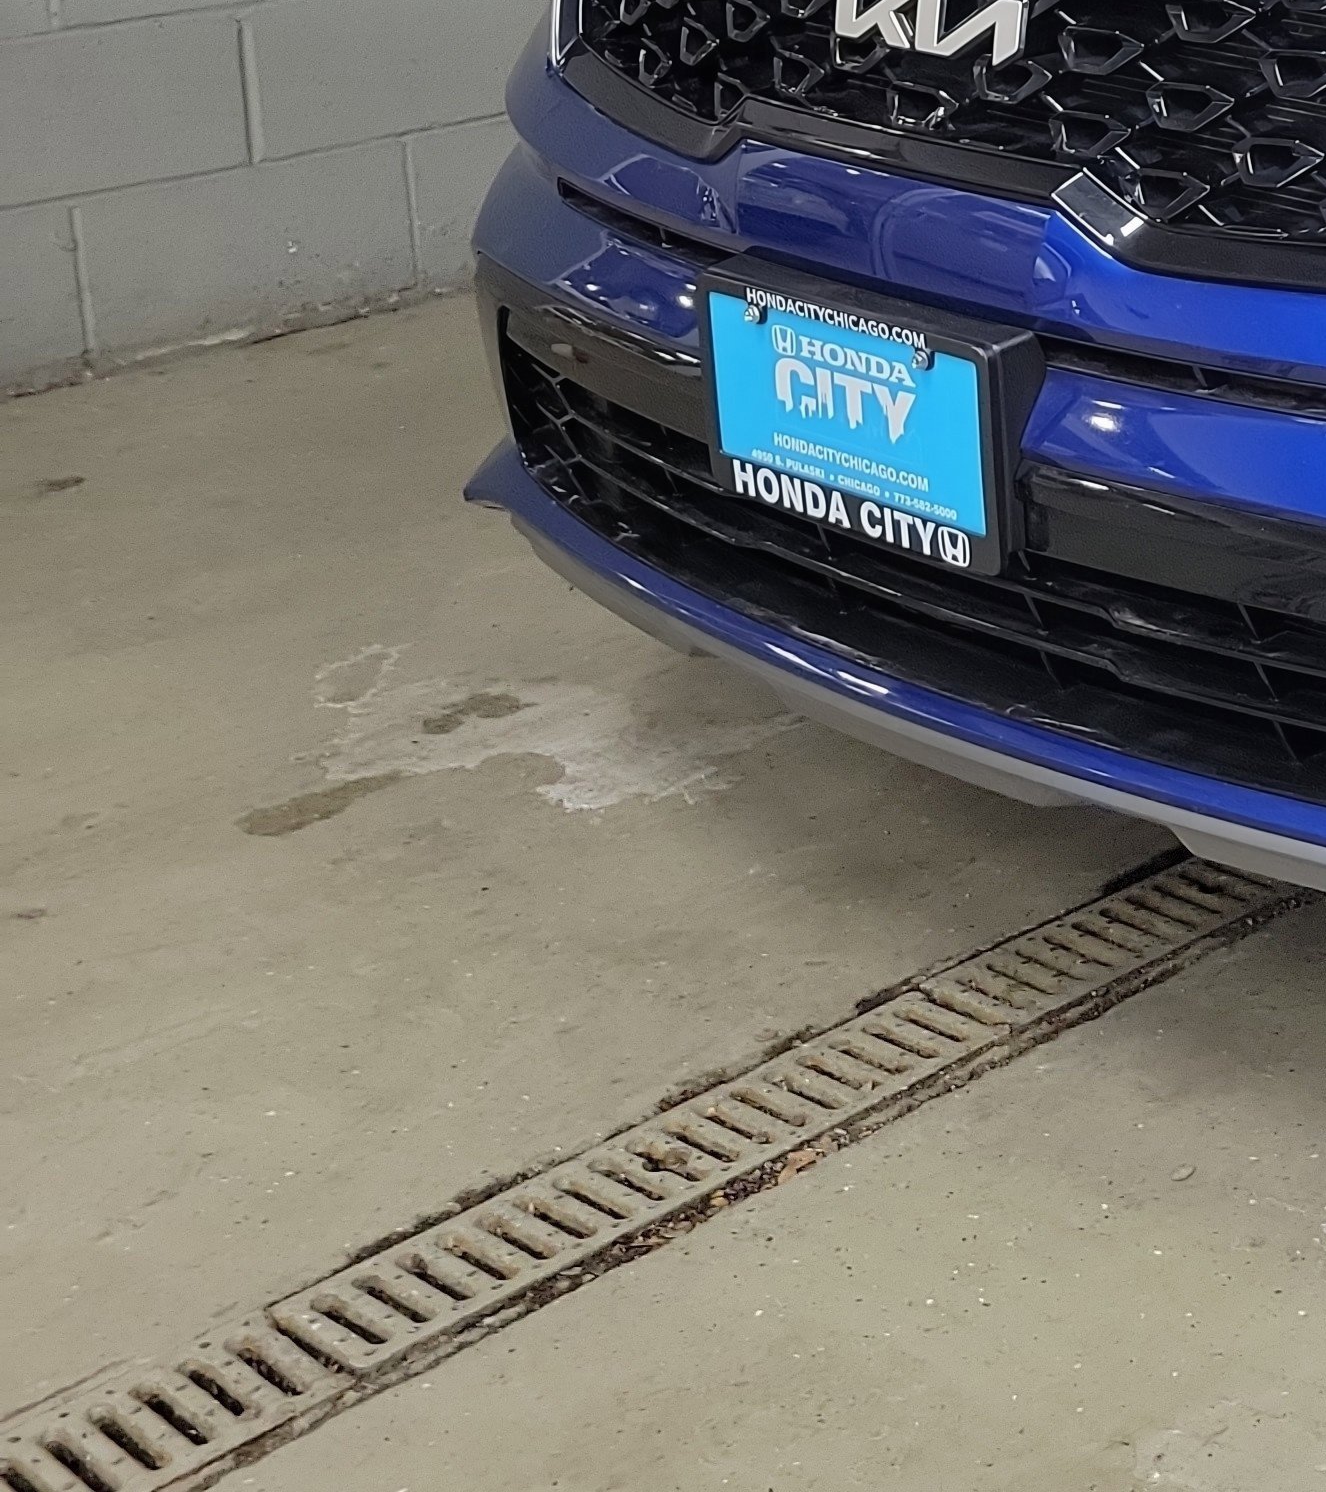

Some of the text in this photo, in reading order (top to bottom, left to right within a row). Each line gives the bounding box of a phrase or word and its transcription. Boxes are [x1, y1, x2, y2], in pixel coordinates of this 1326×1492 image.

[746, 287, 927, 350] HONDACITYCHICAGO.COM
[798, 335, 917, 388] HONDA
[774, 357, 917, 445] CITY
[773, 431, 930, 493] HONDACITYCHICAGO.COM
[786, 457, 826, 480] PULASKI
[837, 474, 881, 498] CHICAGO
[893, 491, 958, 521] 773-582-5000
[731, 458, 852, 530] HONDA
[859, 500, 938, 557] CITY
